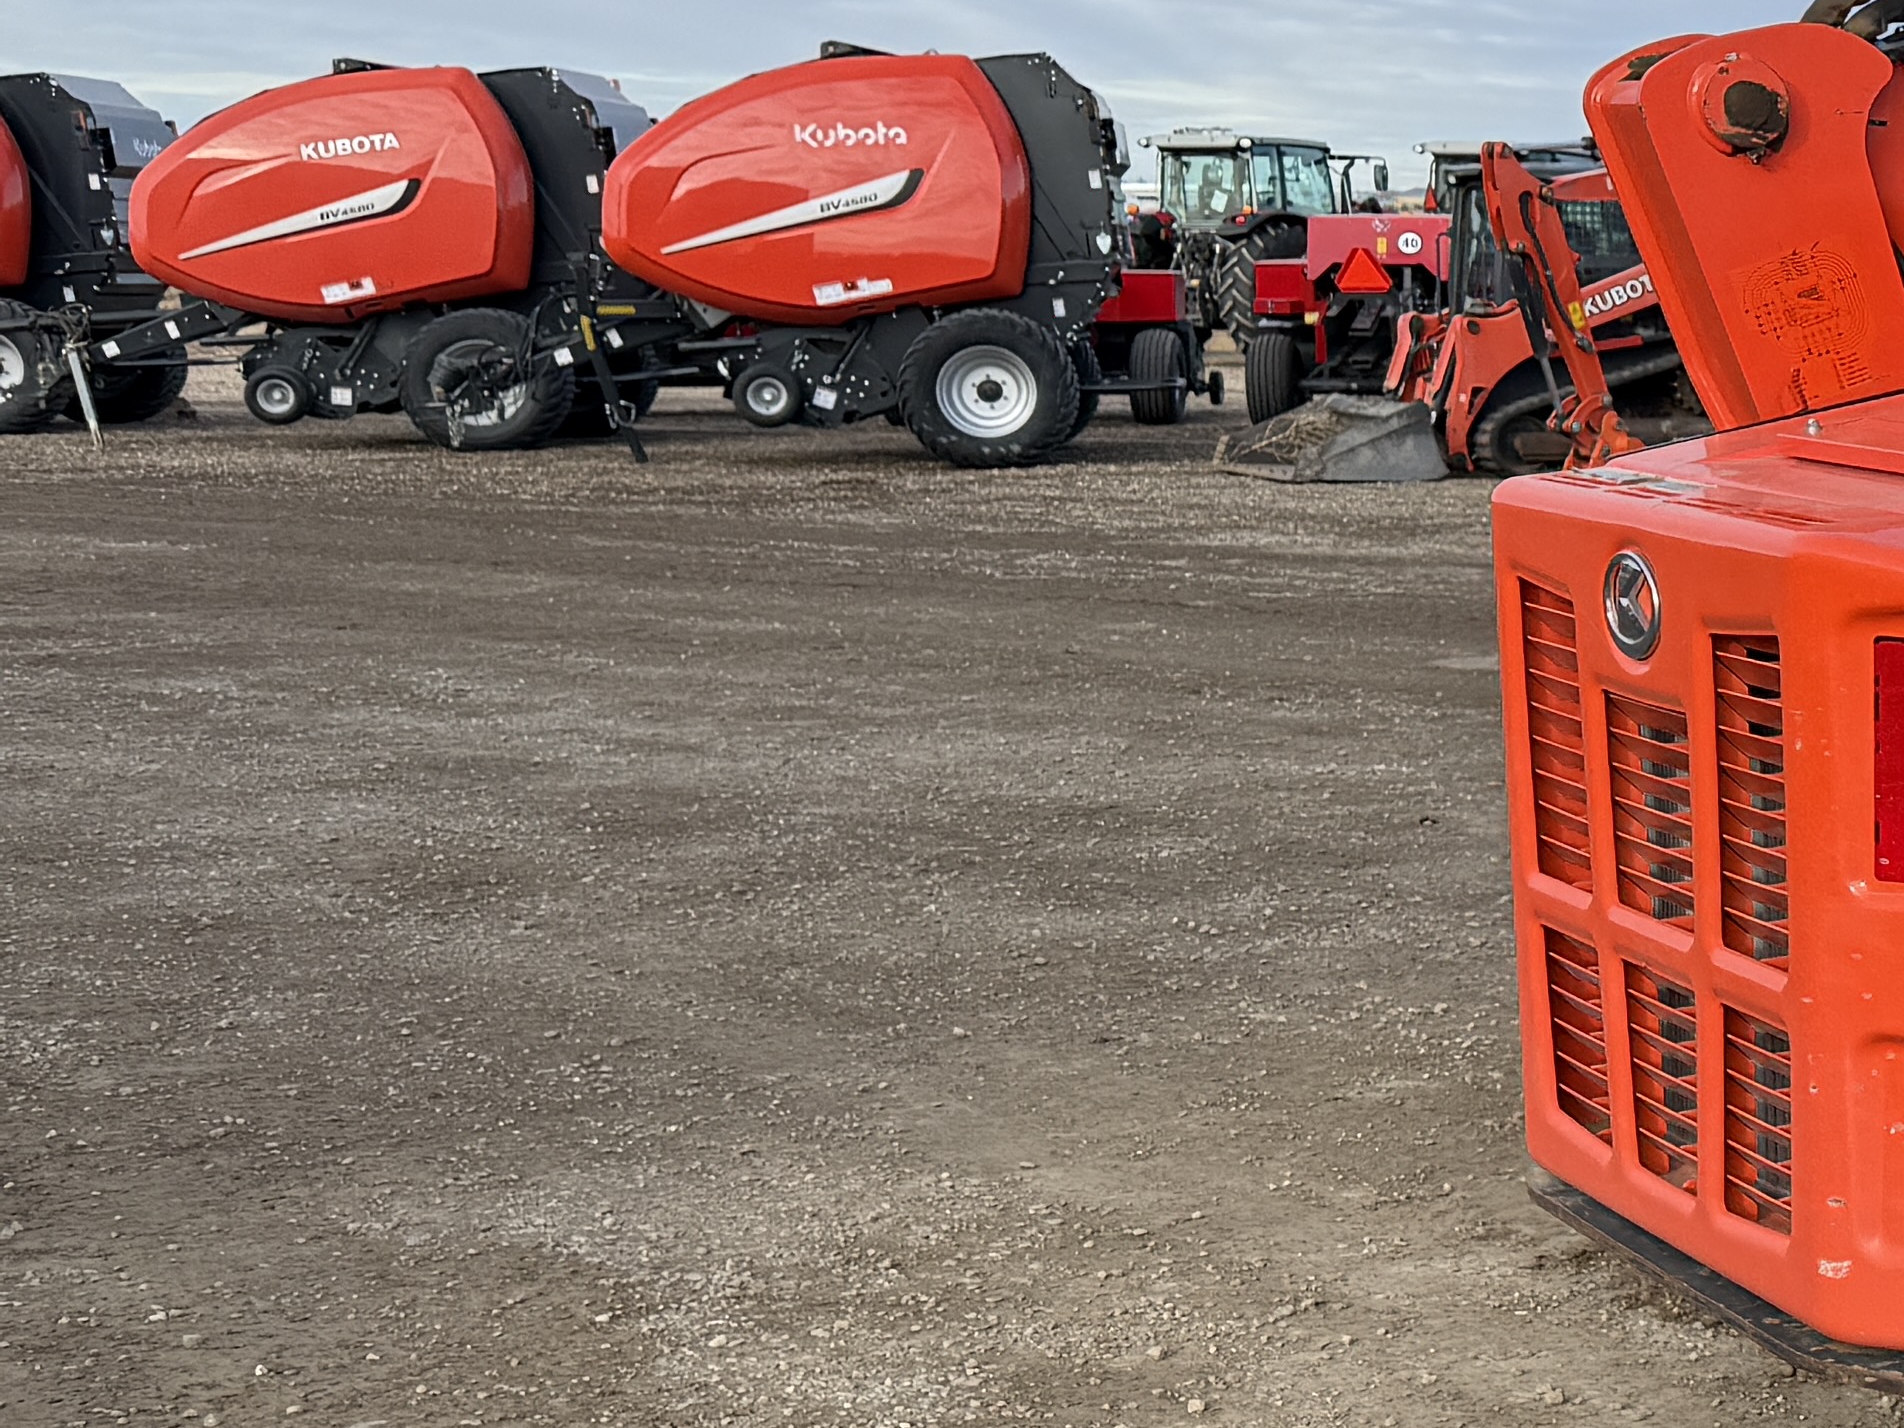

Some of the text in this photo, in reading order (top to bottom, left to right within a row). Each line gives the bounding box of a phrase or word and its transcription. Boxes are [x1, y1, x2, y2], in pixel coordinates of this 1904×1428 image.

[300, 132, 400, 161] KUBOTA
[793, 121, 907, 148] Kubota
[1583, 274, 1654, 318] KUBOT
